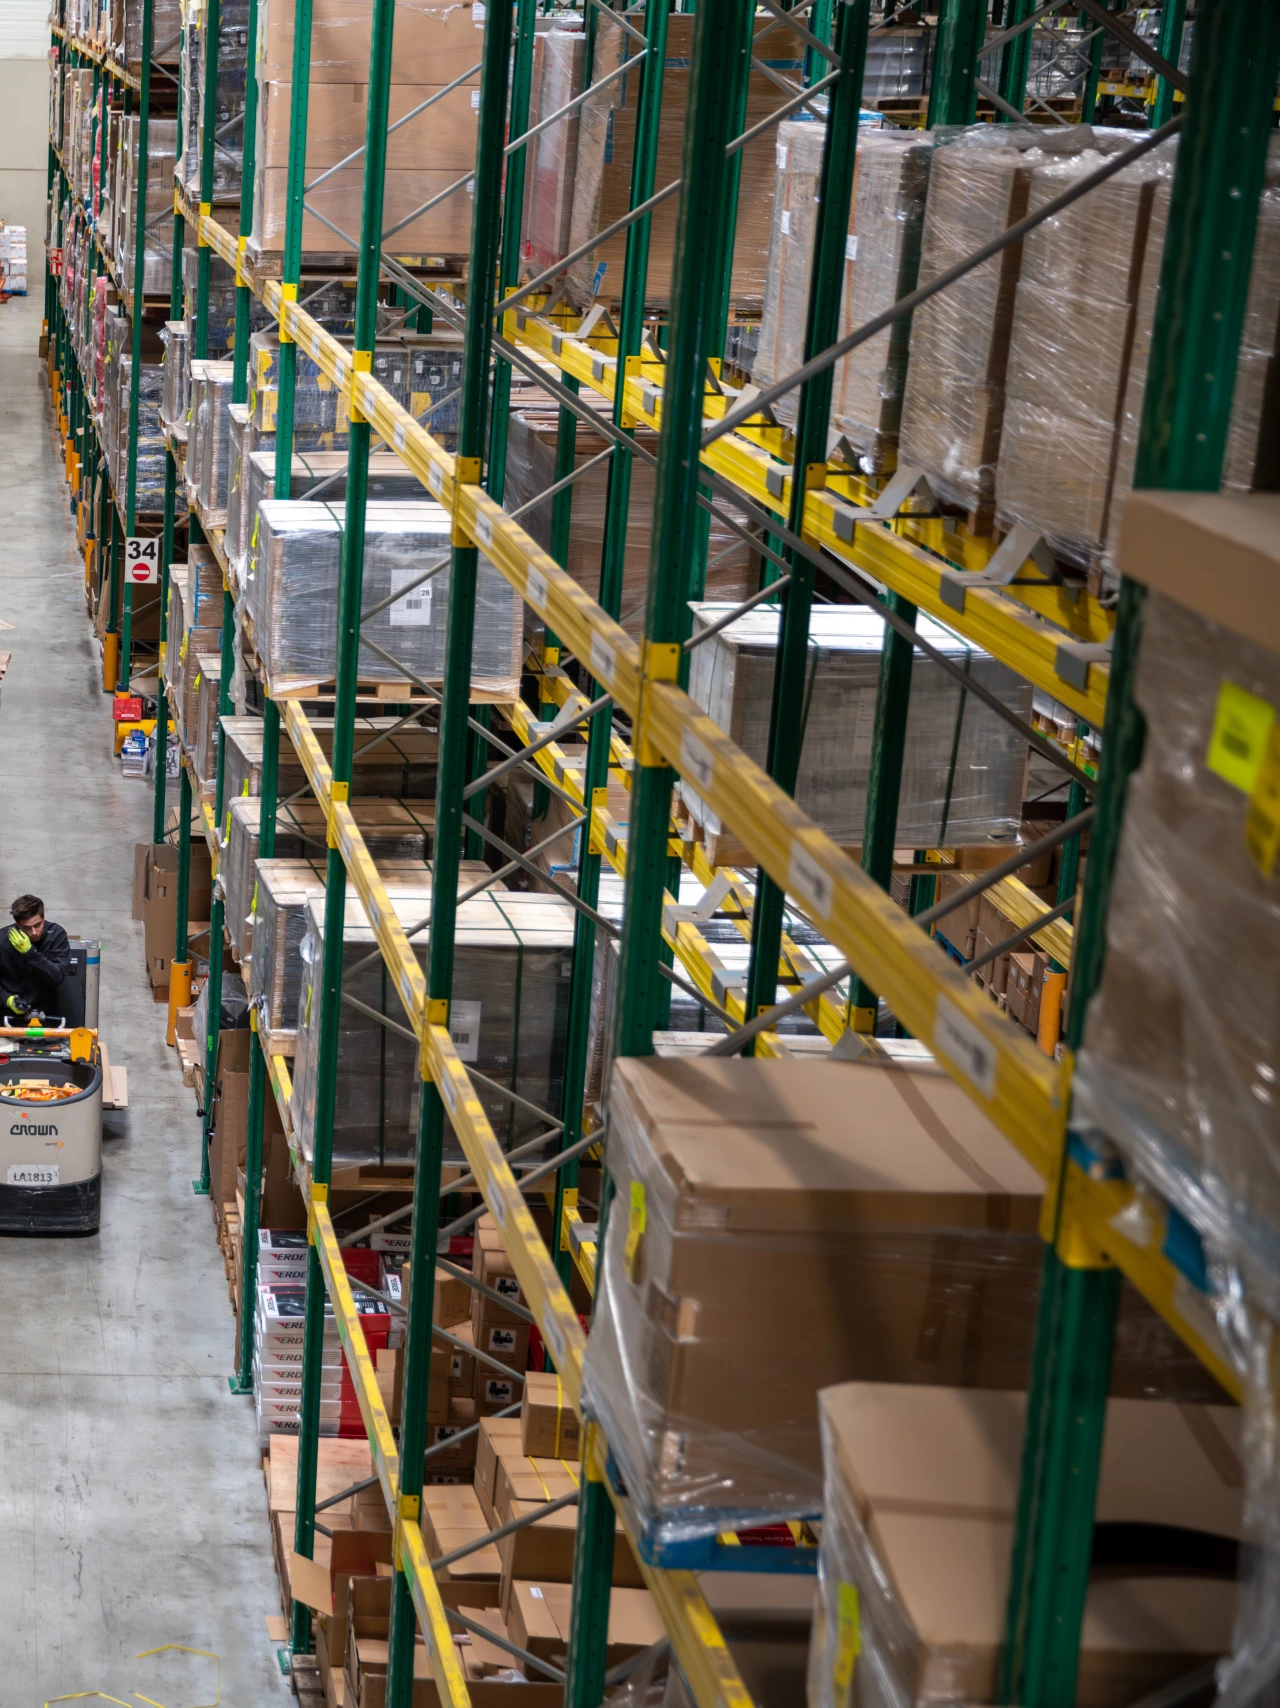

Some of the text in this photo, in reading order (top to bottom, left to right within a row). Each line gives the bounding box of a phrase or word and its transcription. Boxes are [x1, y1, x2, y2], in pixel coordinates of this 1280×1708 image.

[128, 541, 156, 560] 34
[10, 1124, 58, 1136] CROWN
[13, 1172, 52, 1182] LA1813
